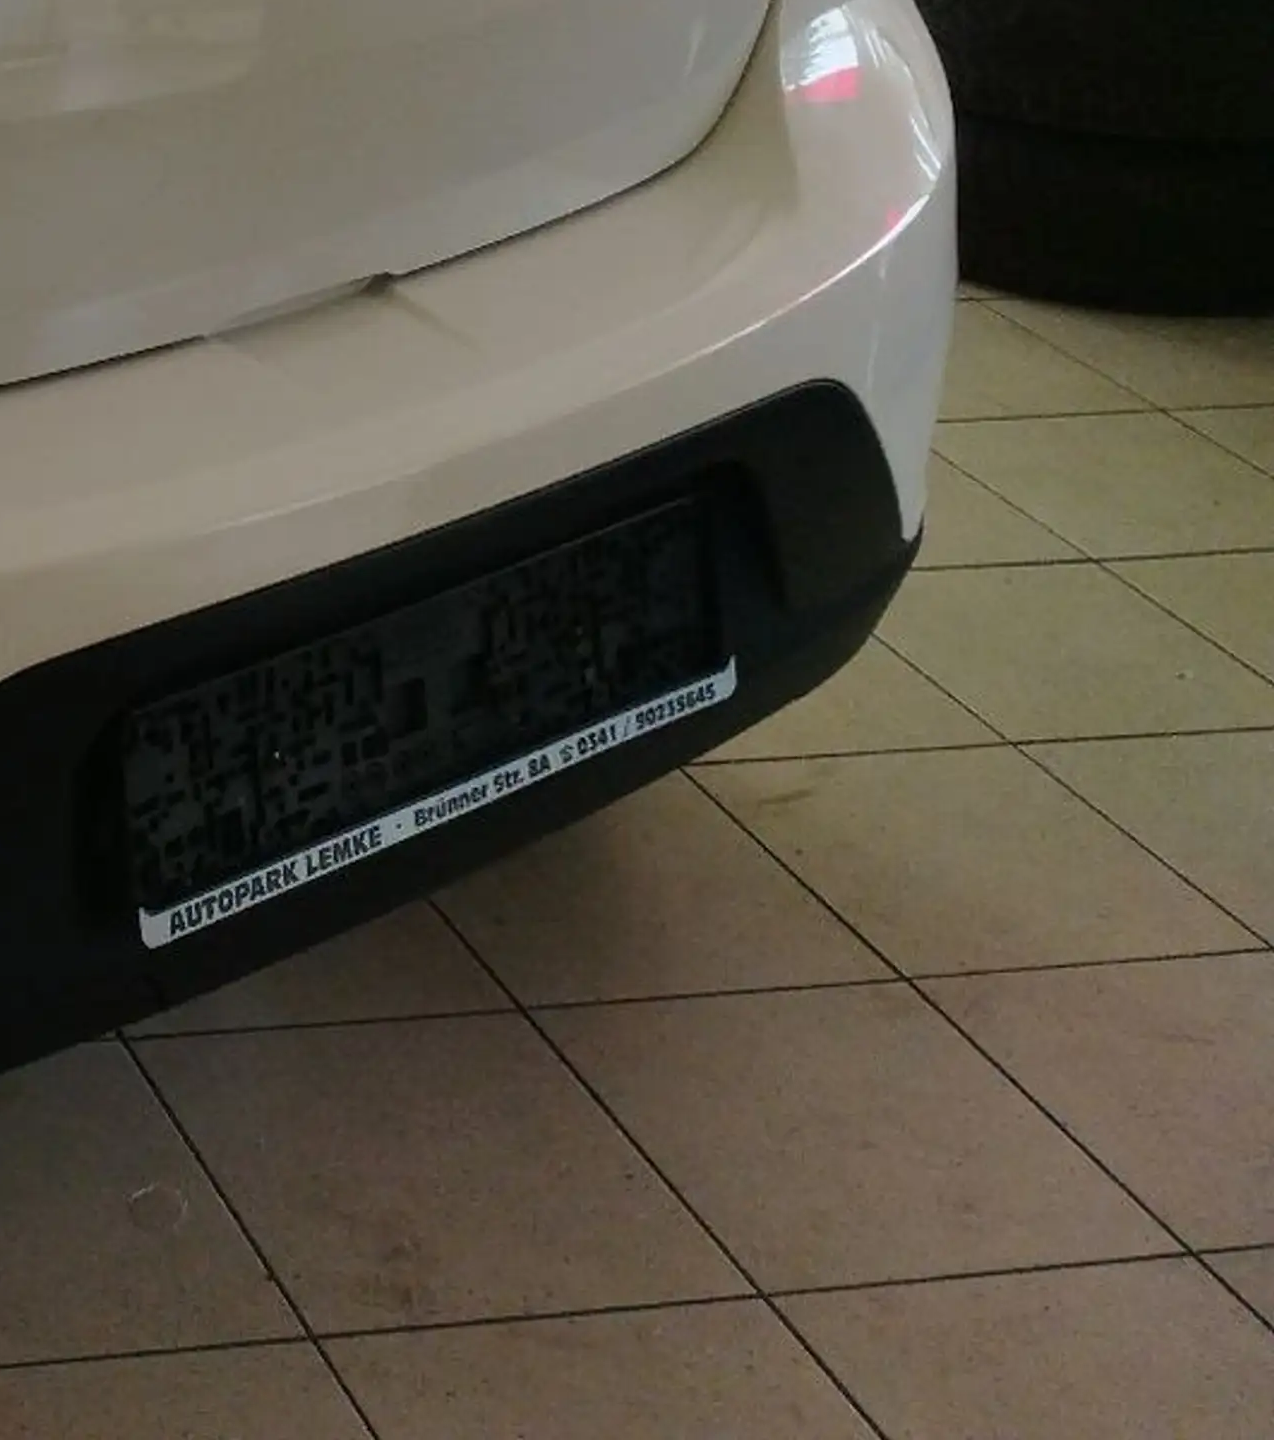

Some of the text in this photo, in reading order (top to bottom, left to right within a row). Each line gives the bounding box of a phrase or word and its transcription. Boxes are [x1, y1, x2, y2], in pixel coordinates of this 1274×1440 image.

[168, 860, 299, 936] AUTOPARK
[305, 825, 383, 877] LEMKE
[414, 780, 492, 826] Brünner
[493, 769, 524, 794] Str.
